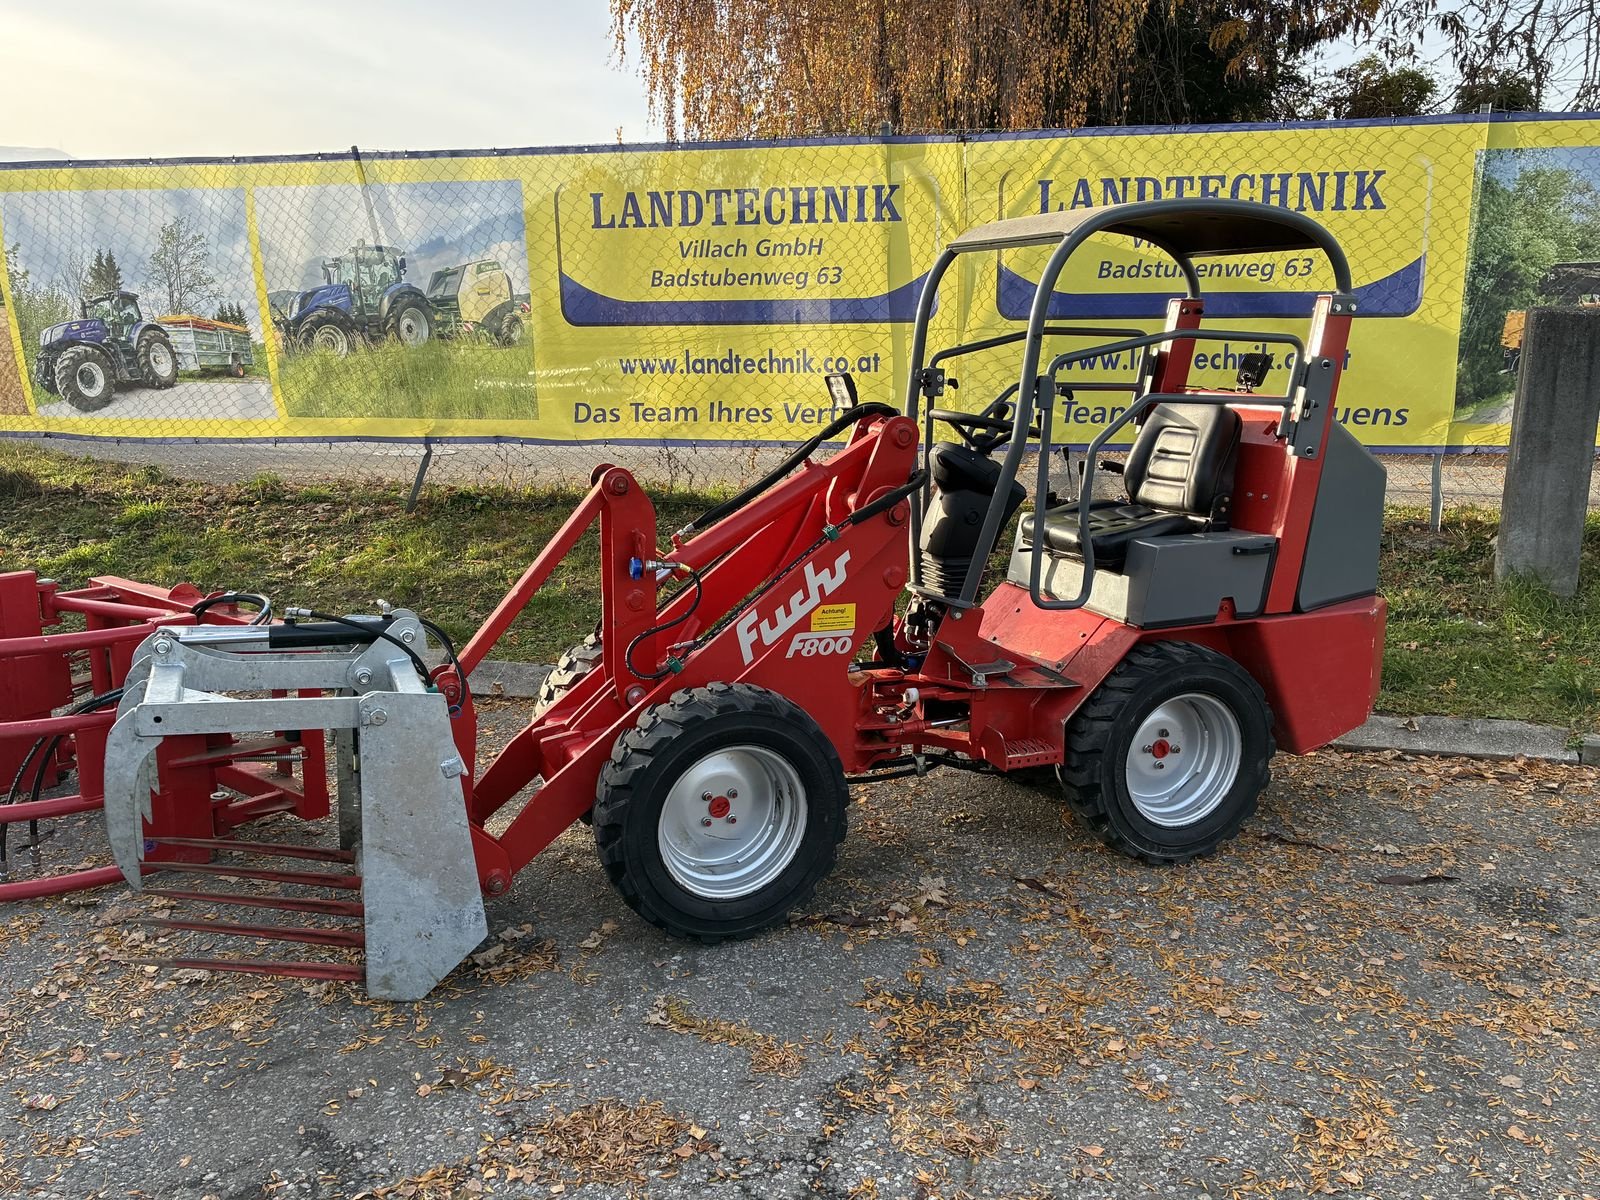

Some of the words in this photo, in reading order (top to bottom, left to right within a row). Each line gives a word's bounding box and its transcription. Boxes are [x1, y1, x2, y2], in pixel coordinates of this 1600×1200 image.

[591, 184, 903, 229] LANDTECHNIK
[679, 239, 748, 259] Villach
[755, 237, 824, 257] GmbH
[650, 268, 809, 290] Badstubenweg
[816, 266, 843, 285] 63
[1284, 257, 1315, 277] 63
[619, 348, 881, 375] www.landtechnik.co.at
[574, 403, 621, 424] Das
[630, 402, 698, 423] Team
[709, 402, 773, 423] Ihres
[736, 549, 851, 666] Fuchs
[821, 607, 847, 615] Achtung!
[785, 629, 855, 659] F800
